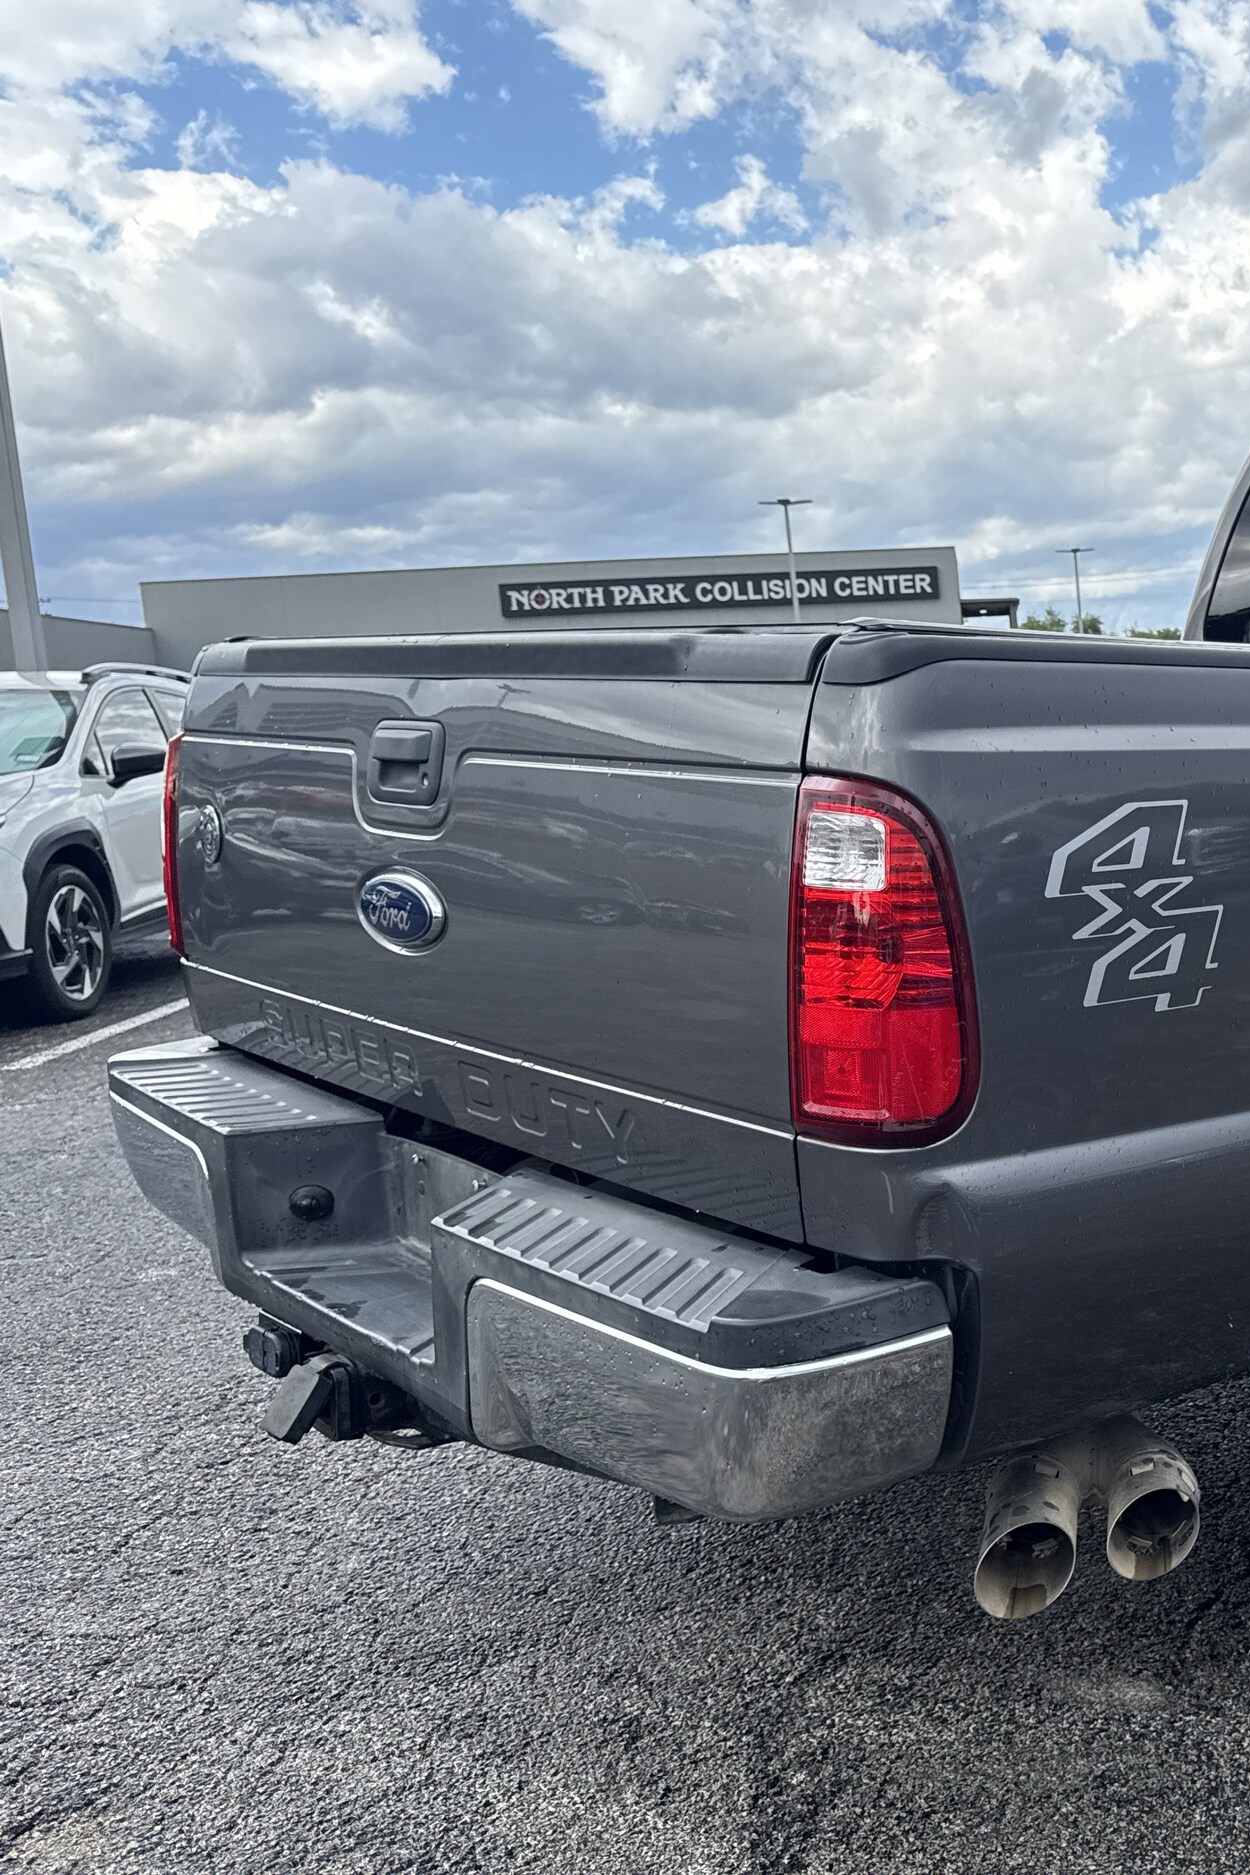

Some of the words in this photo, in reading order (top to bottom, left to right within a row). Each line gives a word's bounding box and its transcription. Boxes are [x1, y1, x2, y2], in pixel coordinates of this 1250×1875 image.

[507, 585, 605, 612] NORTH
[611, 582, 690, 606] PARK
[694, 577, 828, 603] COLLISION
[833, 573, 932, 598] CENTER
[363, 885, 412, 931] Ford
[259, 999, 424, 1098] SUPER
[458, 1060, 636, 1165] DUTY
